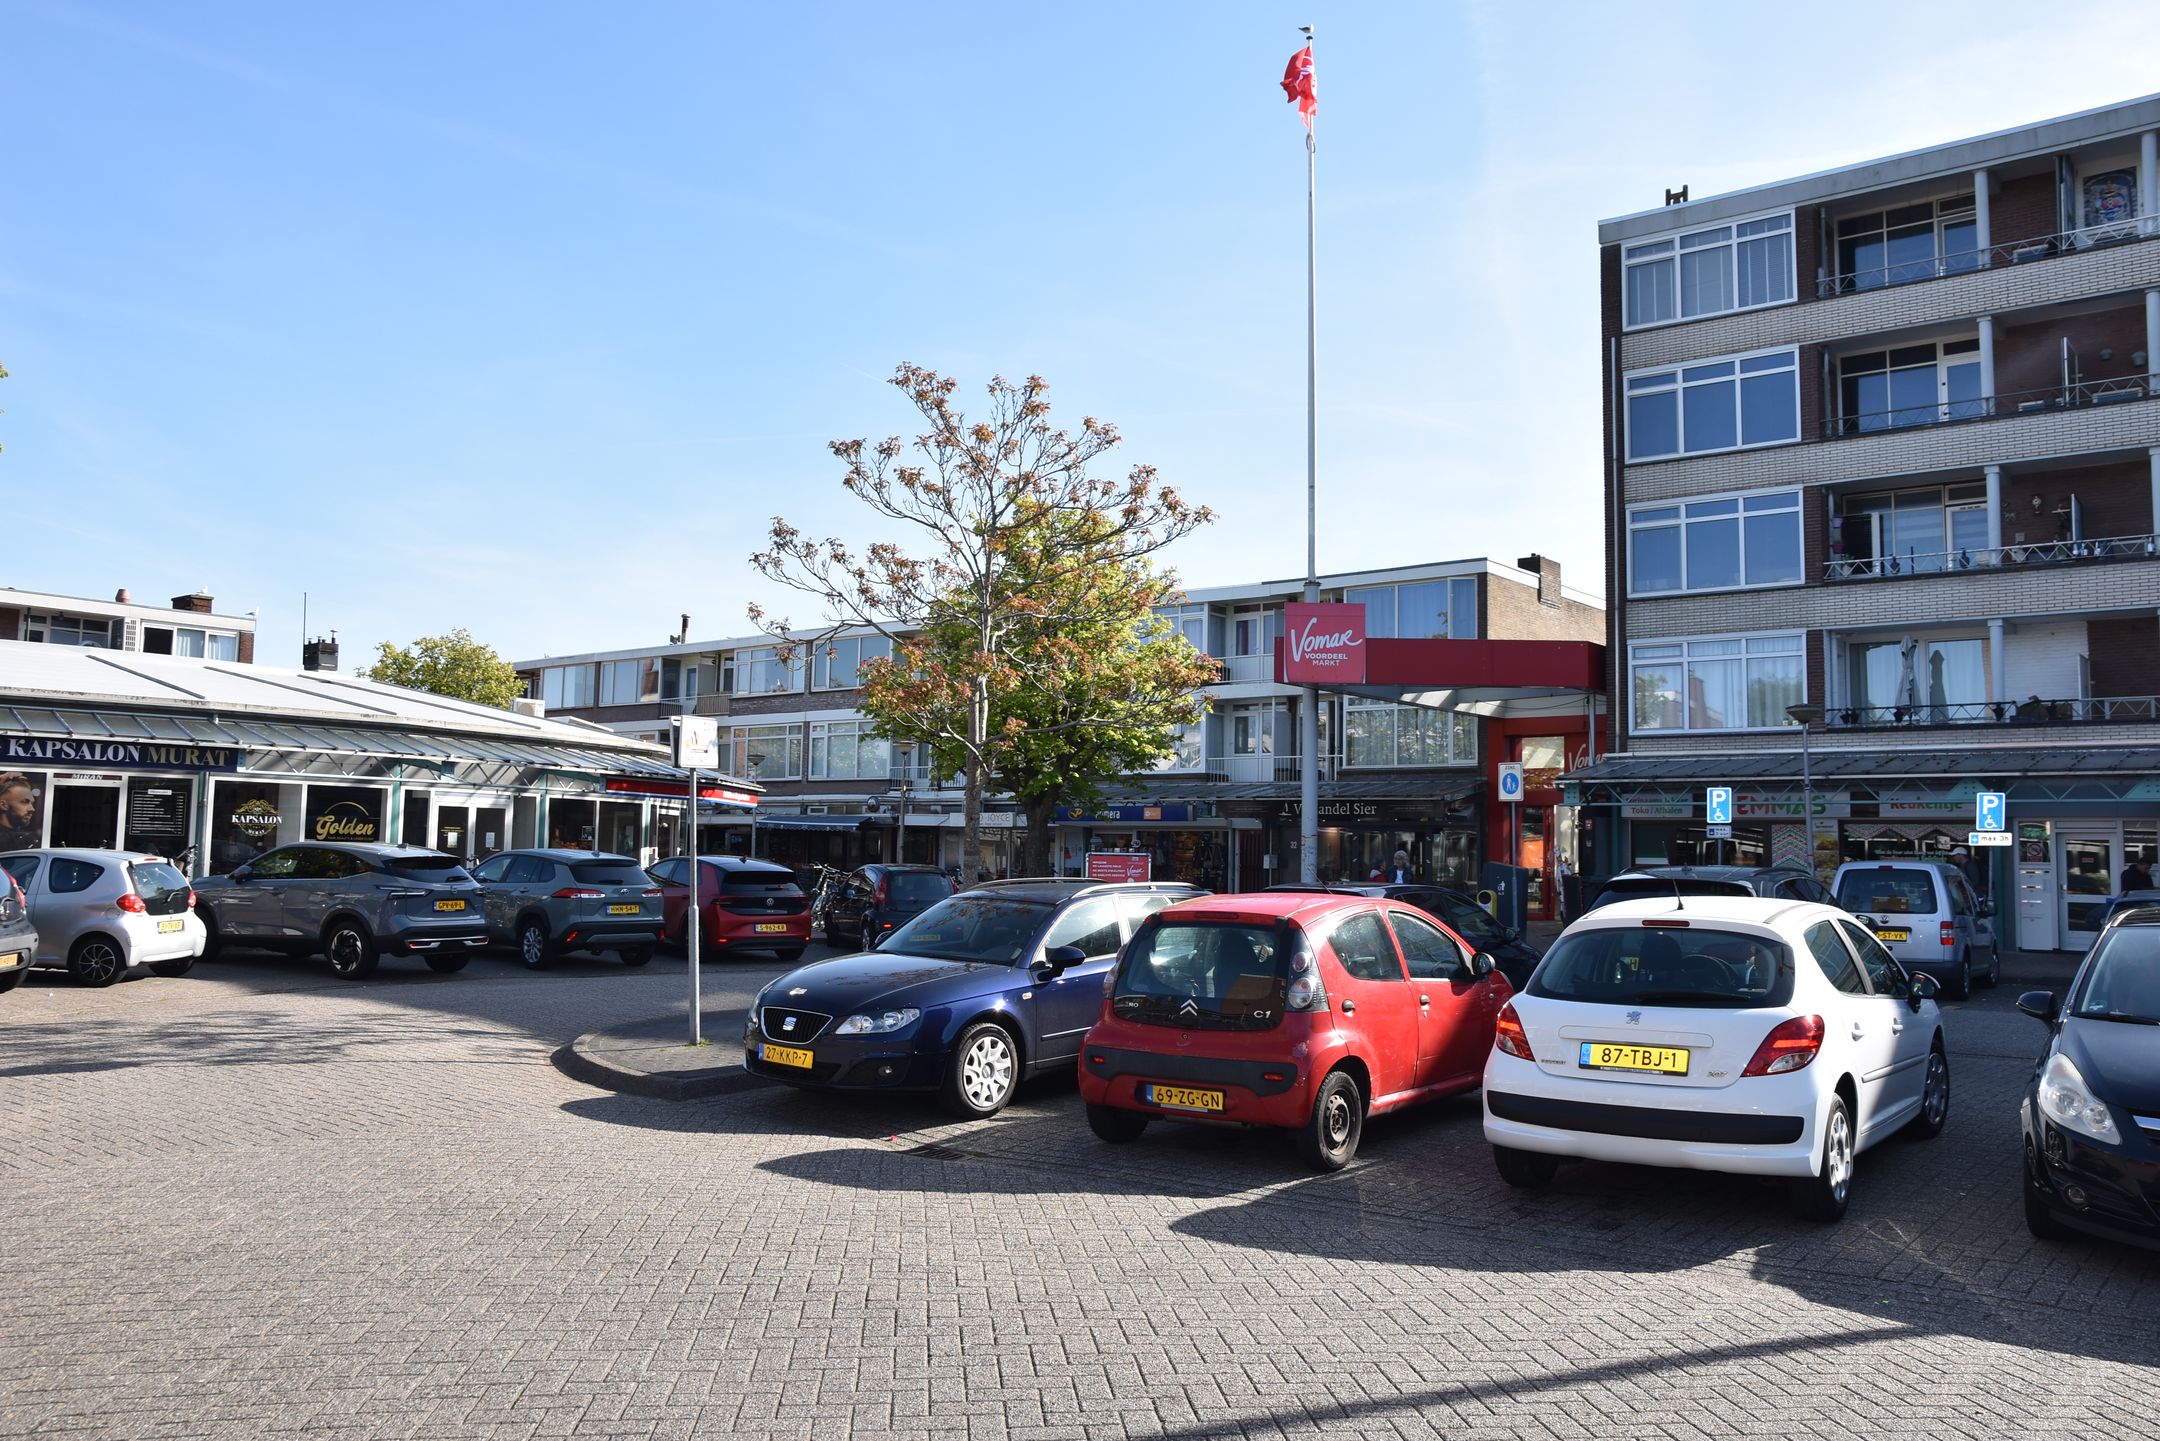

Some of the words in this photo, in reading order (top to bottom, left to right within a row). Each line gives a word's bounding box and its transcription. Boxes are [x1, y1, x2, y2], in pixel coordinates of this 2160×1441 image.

[1291, 617, 1363, 662] Vomar
[7, 738, 142, 763] KAPSALON
[146, 746, 230, 767] MURAT
[1353, 803, 1377, 815] Sier
[1712, 790, 1727, 808] P
[1983, 795, 1999, 815] P
[231, 814, 283, 825] KAPSALON
[987, 813, 1010, 822] JOYCE
[1654, 806, 1683, 814] Afhalen
[316, 815, 376, 841] Golden
[1253, 1010, 1273, 1019] C1
[765, 1046, 808, 1066] 27-KKP-7
[1601, 1048, 1677, 1068] 87-TBJ-1
[1156, 1087, 1220, 1108] 69-ZG-GN
